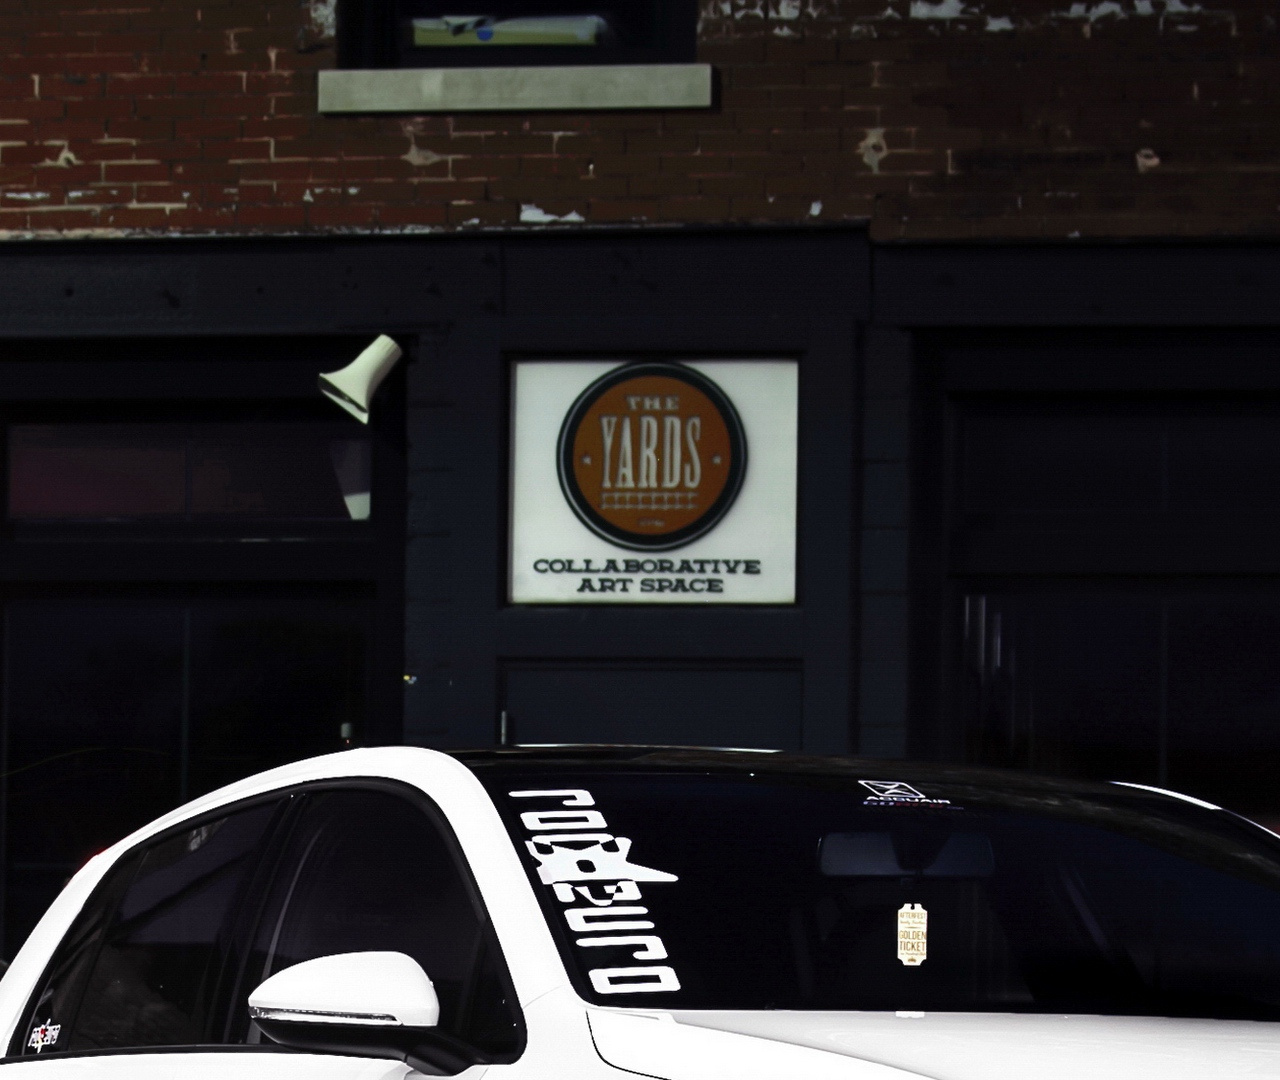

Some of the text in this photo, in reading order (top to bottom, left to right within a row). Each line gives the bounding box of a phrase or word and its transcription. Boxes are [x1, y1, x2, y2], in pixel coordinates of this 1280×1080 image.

[626, 396, 680, 411] THE
[600, 415, 702, 489] YARDS
[533, 559, 761, 575] COLLABORATIVE
[577, 578, 724, 594] ART SPACE
[899, 930, 927, 940] GOLDEN
[899, 940, 926, 951] TICKET
